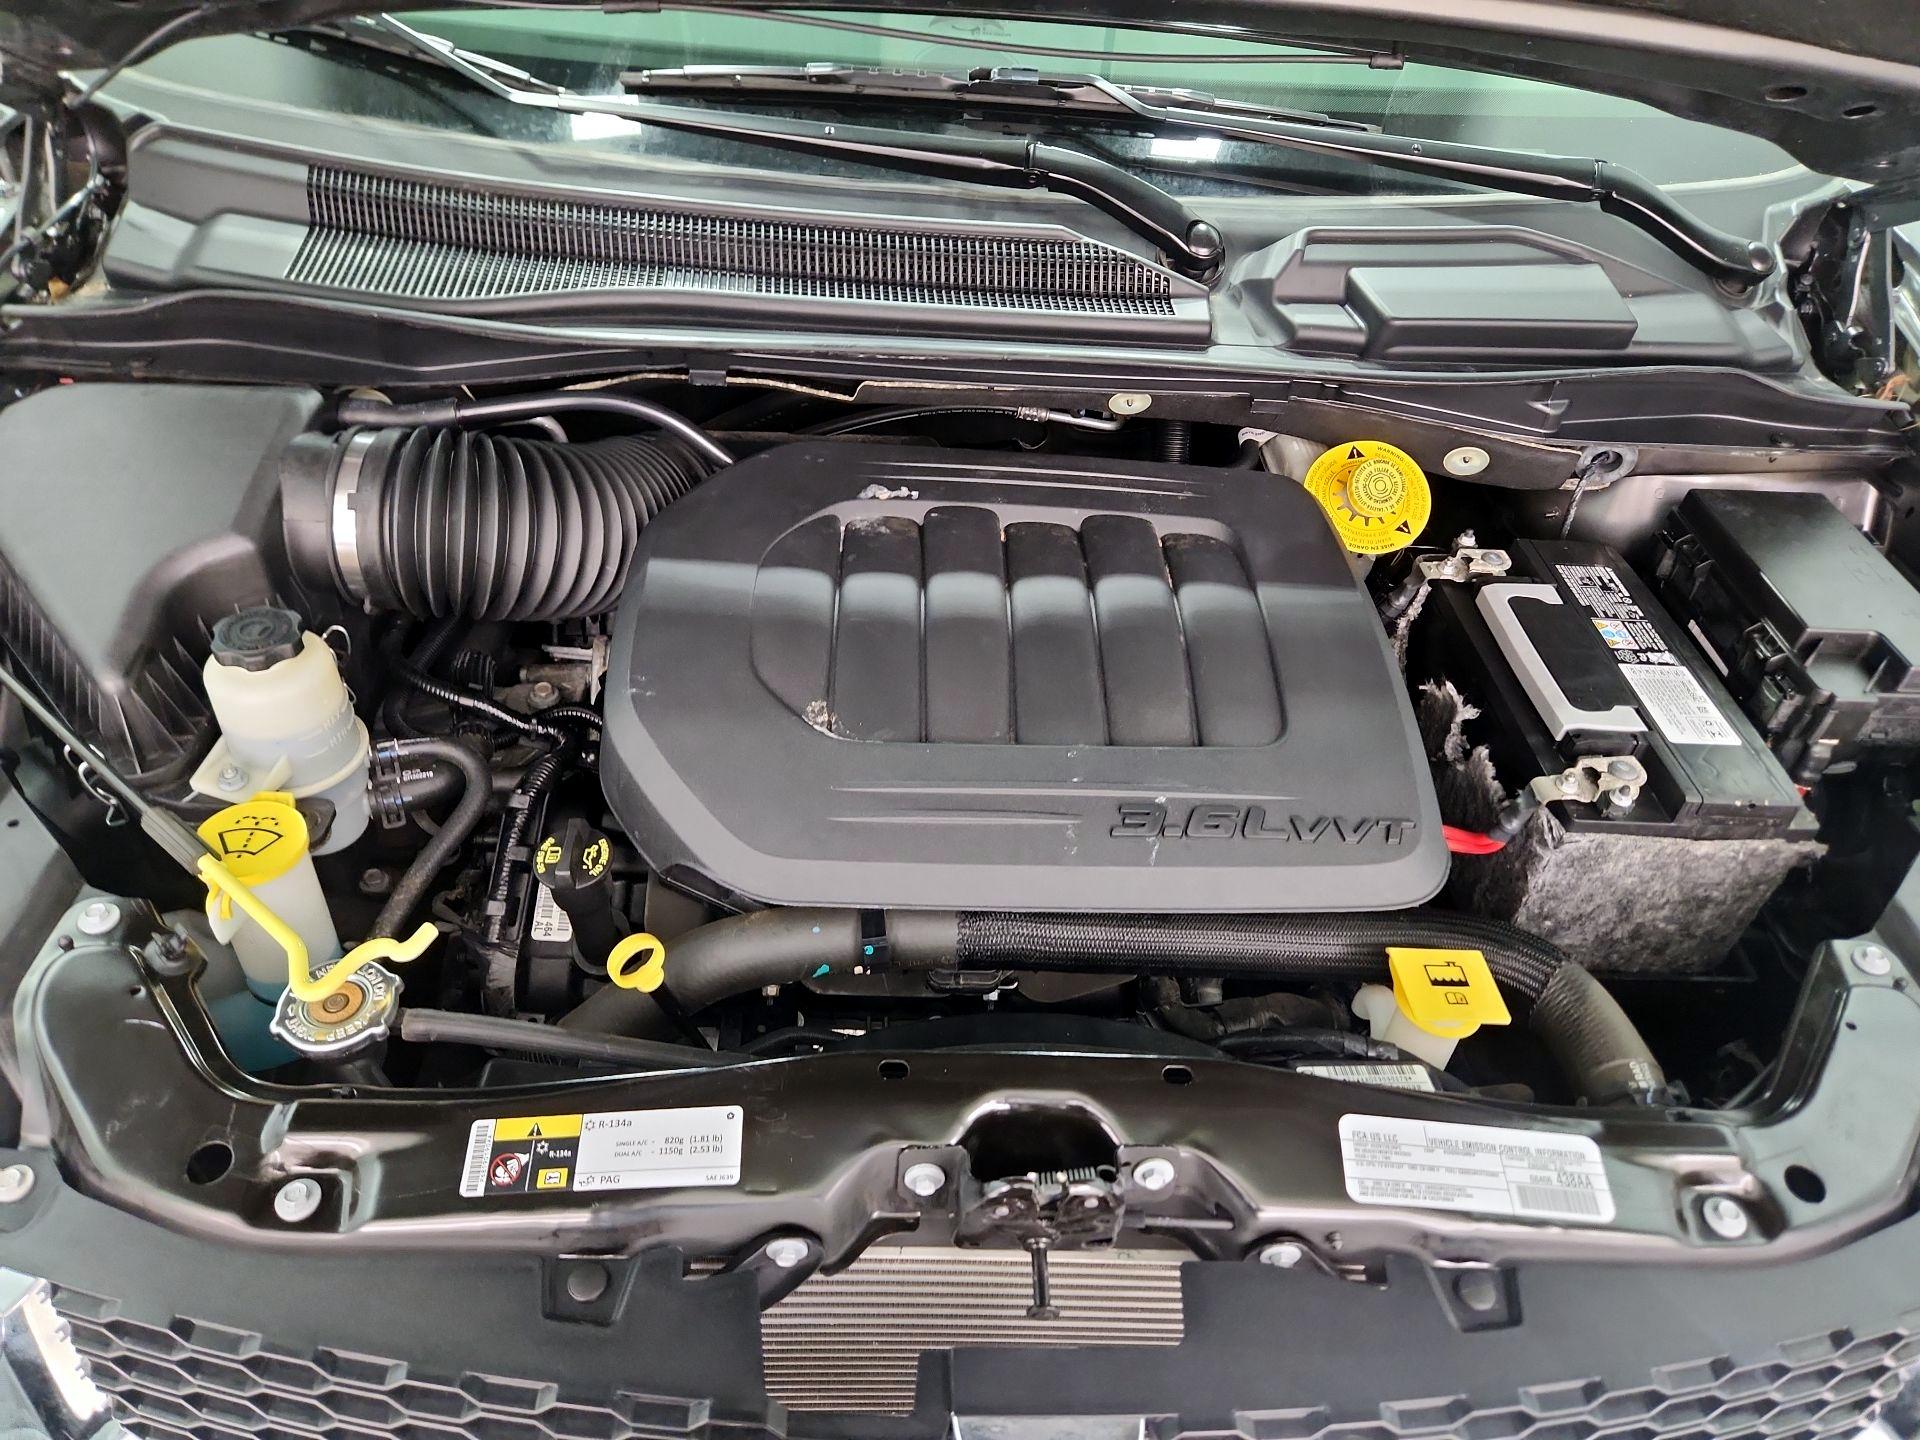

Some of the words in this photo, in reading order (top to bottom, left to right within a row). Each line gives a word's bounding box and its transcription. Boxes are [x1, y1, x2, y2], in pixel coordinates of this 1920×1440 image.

[1110, 803, 1291, 839] 3.6L
[1290, 814, 1416, 845] VVT
[598, 838, 609, 865] ENGINE
[588, 864, 603, 877] OIL
[543, 921, 553, 936] 464
[598, 1119, 632, 1129] R-134a
[664, 1136, 684, 1145] 820g
[690, 1135, 709, 1145] (1.81
[712, 1134, 723, 1143] lb)
[659, 1147, 683, 1156] 1150g
[690, 1145, 710, 1155] (2.53
[712, 1144, 723, 1153] lb)
[600, 1174, 620, 1184] PAG
